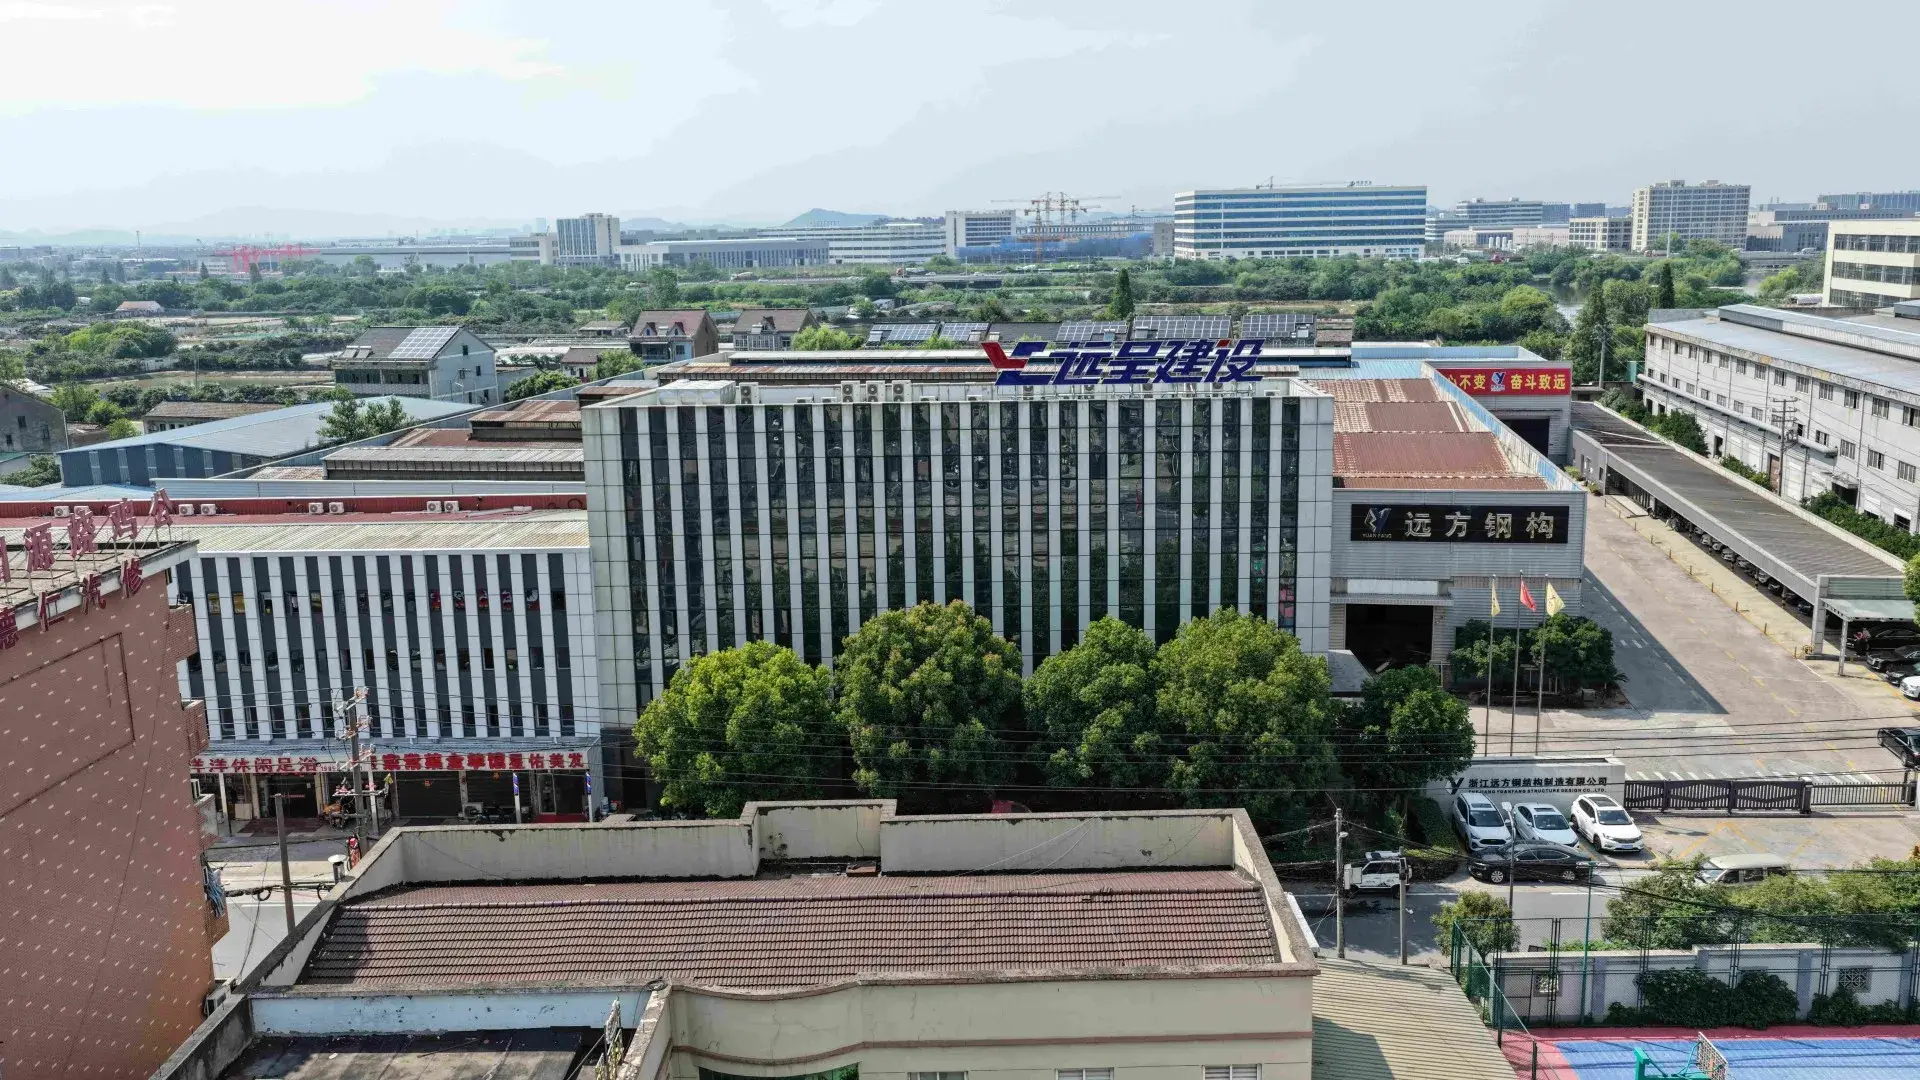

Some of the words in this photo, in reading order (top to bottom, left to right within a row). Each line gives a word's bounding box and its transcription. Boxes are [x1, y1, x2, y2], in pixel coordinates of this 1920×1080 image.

[1510, 374, 1566, 390] 奋斗致远
[1404, 511, 1555, 539] 远方钢构
